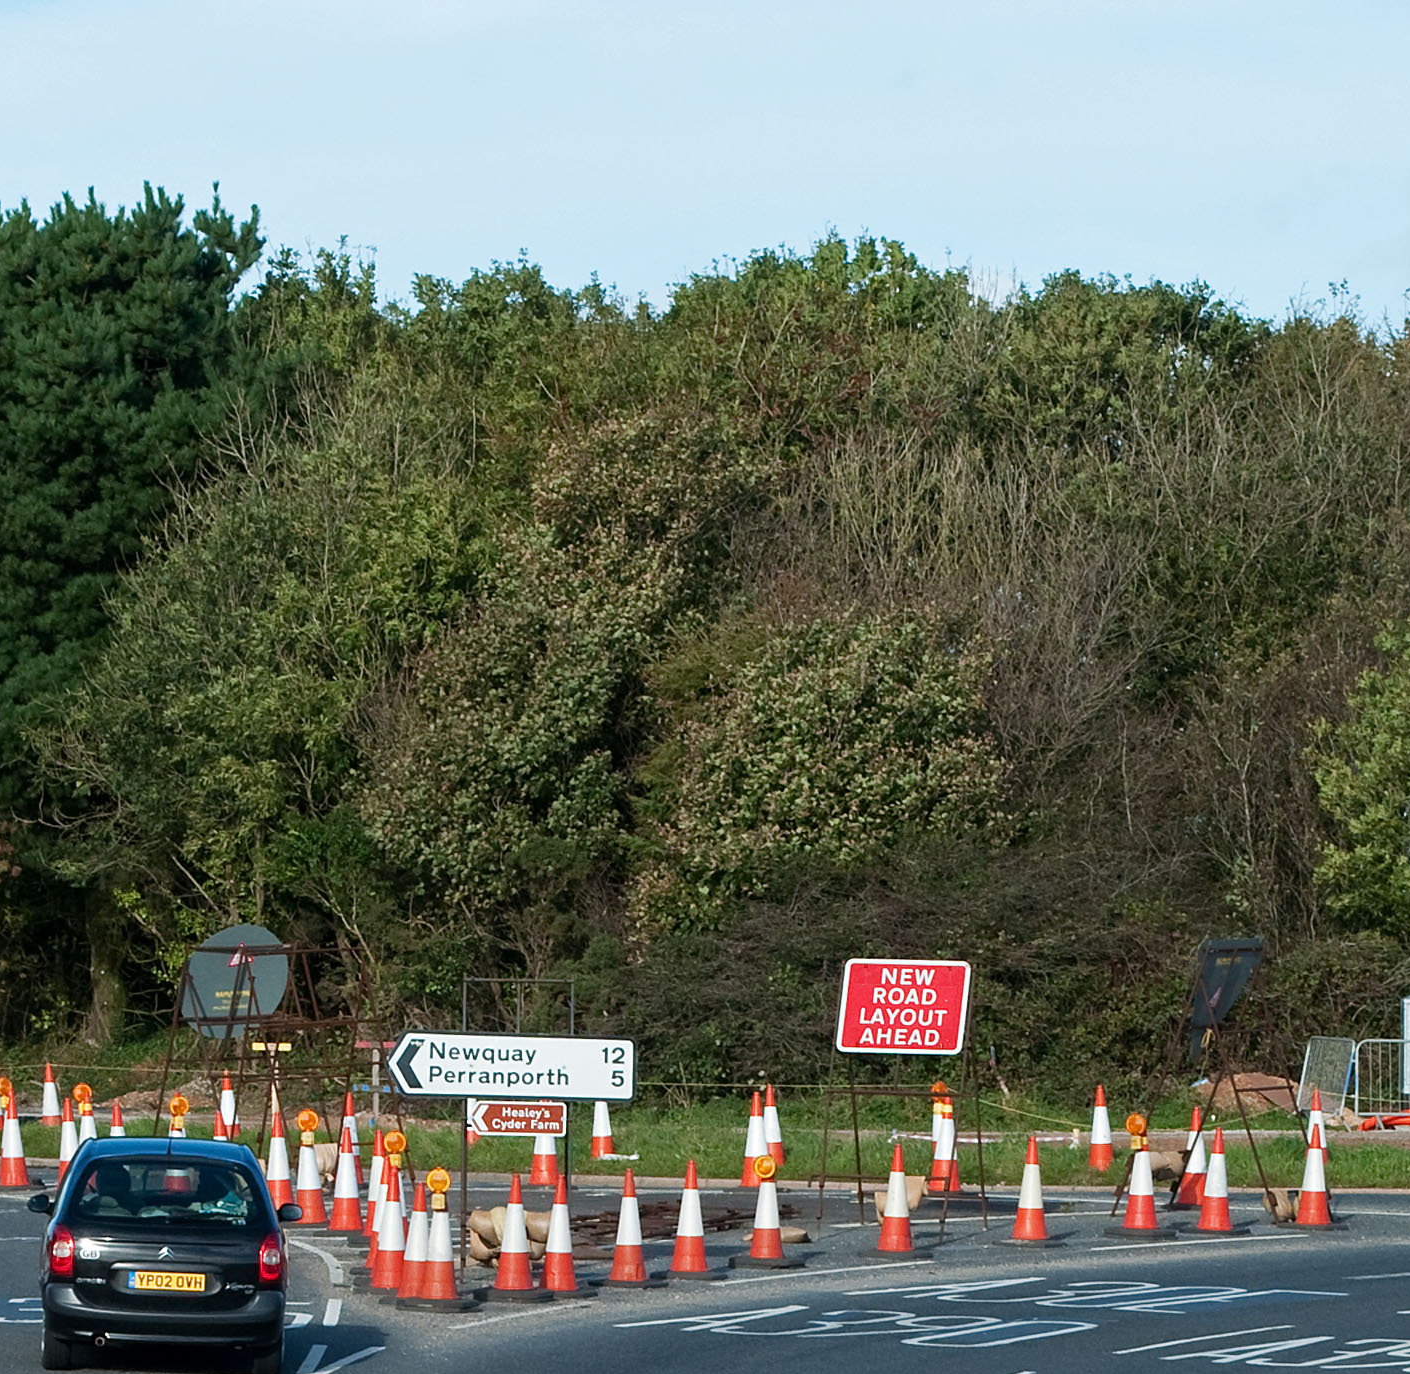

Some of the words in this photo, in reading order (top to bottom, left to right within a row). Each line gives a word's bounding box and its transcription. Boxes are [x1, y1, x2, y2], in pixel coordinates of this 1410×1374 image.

[881, 967, 935, 986] NEW
[872, 987, 937, 1005] ROAD
[859, 1007, 948, 1026] LAYOUT
[858, 1027, 940, 1046] AHEAD
[429, 1042, 537, 1065] Newquay
[601, 1047, 626, 1064] 12
[428, 1066, 570, 1087] Perranporth
[611, 1070, 625, 1087] 5
[501, 1107, 551, 1119] Healey's
[491, 1119, 527, 1131] Cyder
[530, 1120, 561, 1131] Farm
[82, 1250, 99, 1259] GB
[137, 1274, 173, 1288] YP02
[176, 1275, 203, 1290] OVH
